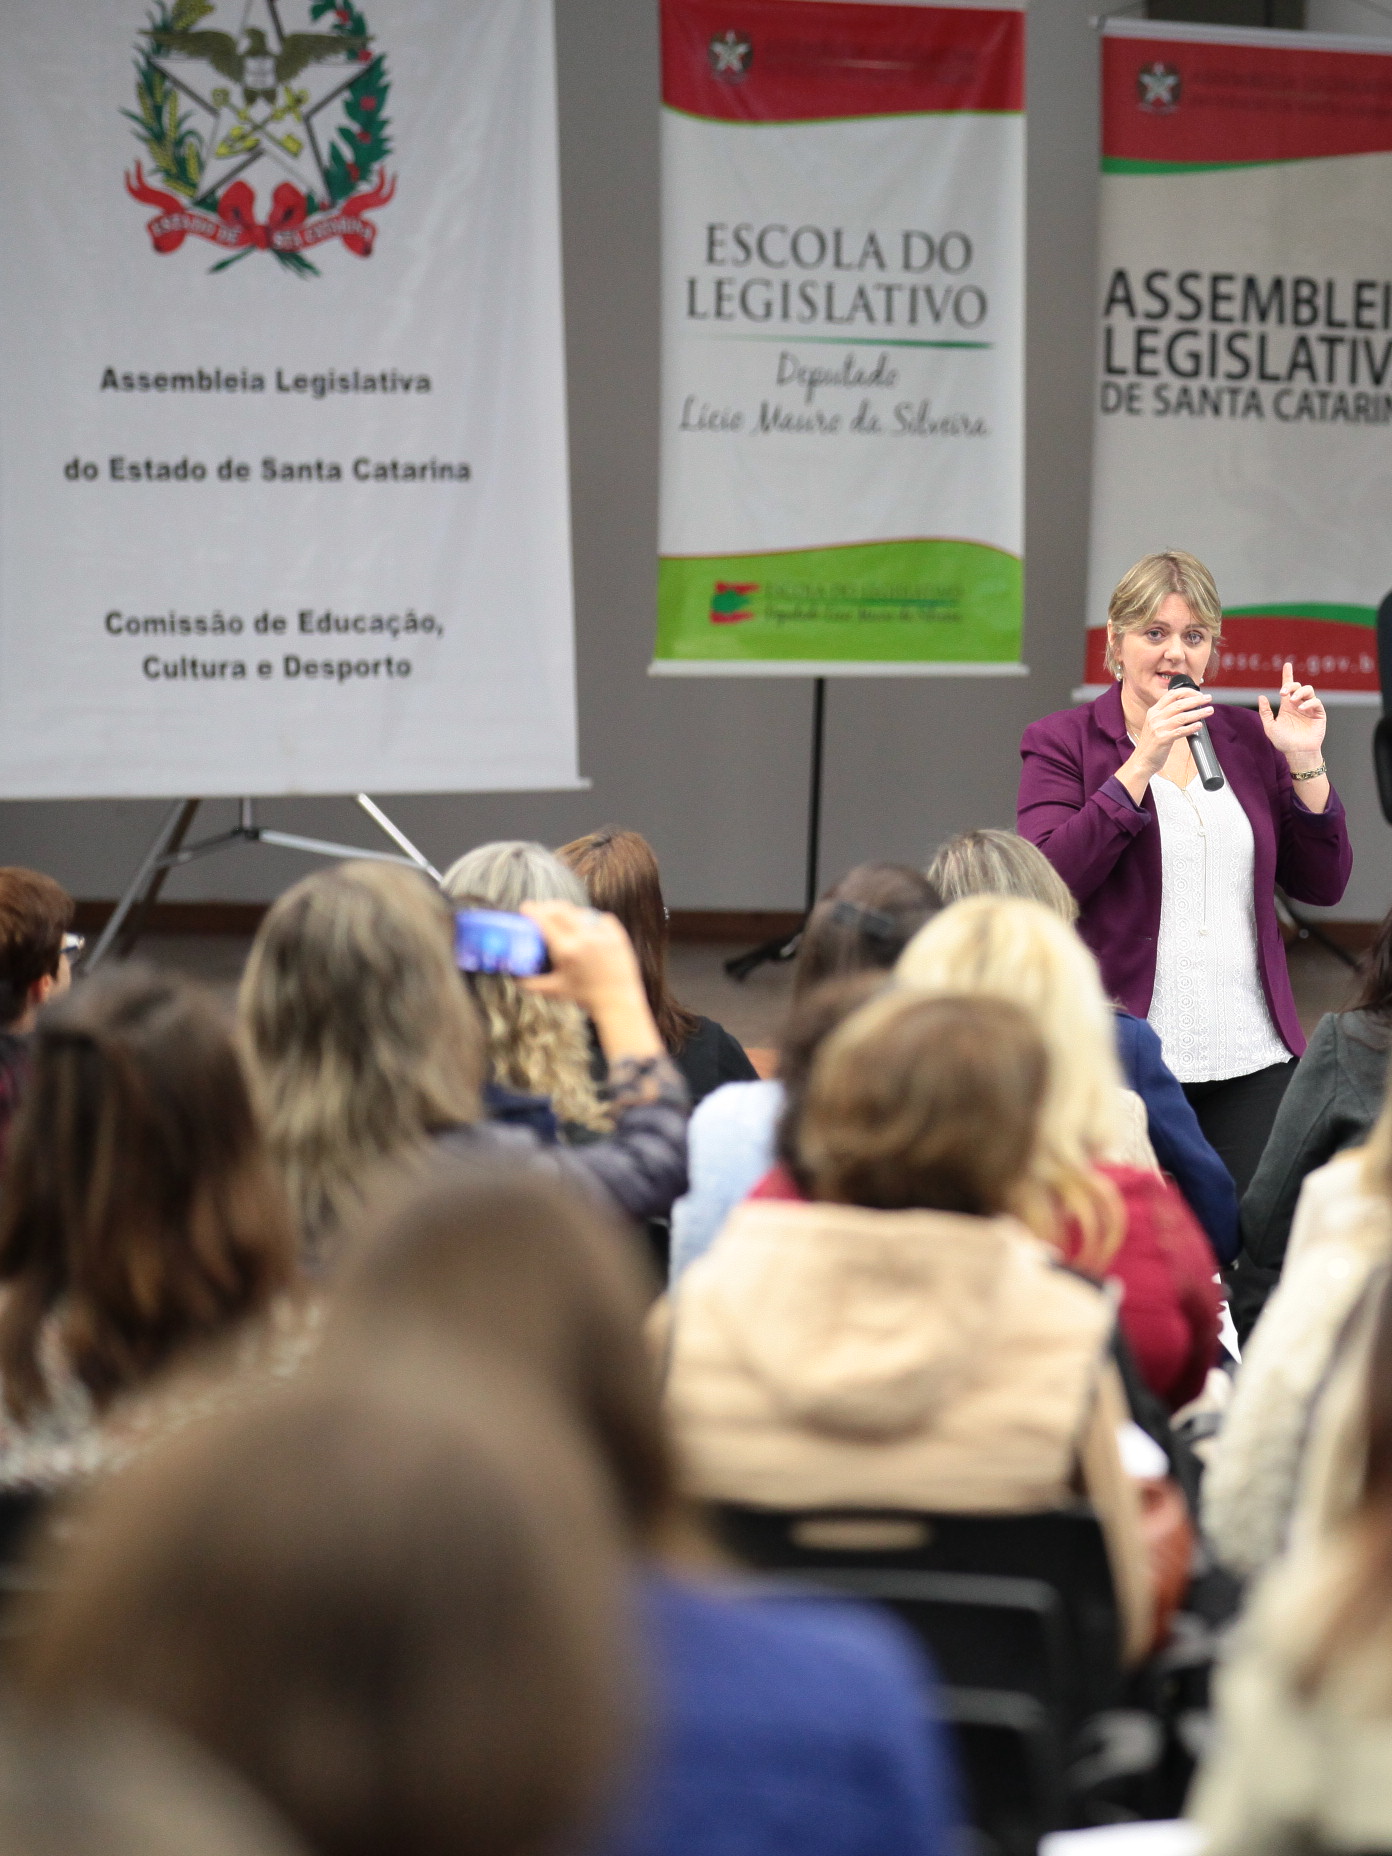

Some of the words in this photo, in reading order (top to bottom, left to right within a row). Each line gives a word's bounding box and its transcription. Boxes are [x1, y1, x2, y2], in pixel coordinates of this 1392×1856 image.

[706, 222, 887, 272] ESCOLA
[902, 229, 973, 275] DO
[686, 276, 988, 329] LEGISLATIVO
[100, 367, 265, 394] Assembleia
[275, 368, 433, 399] Legislativa
[776, 350, 897, 405] Deputado
[1100, 381, 1142, 416] DE
[1153, 382, 1264, 420] SANTA
[64, 456, 98, 482] do
[109, 455, 206, 482] Estado
[217, 456, 251, 482] de
[261, 456, 342, 483] Santa
[353, 456, 472, 483] Catarina
[105, 609, 244, 636] Comissão
[254, 609, 287, 636] de
[298, 608, 444, 639] Educação,
[143, 655, 246, 680] Cultura
[256, 661, 273, 679] e
[284, 655, 412, 683] Desporto
